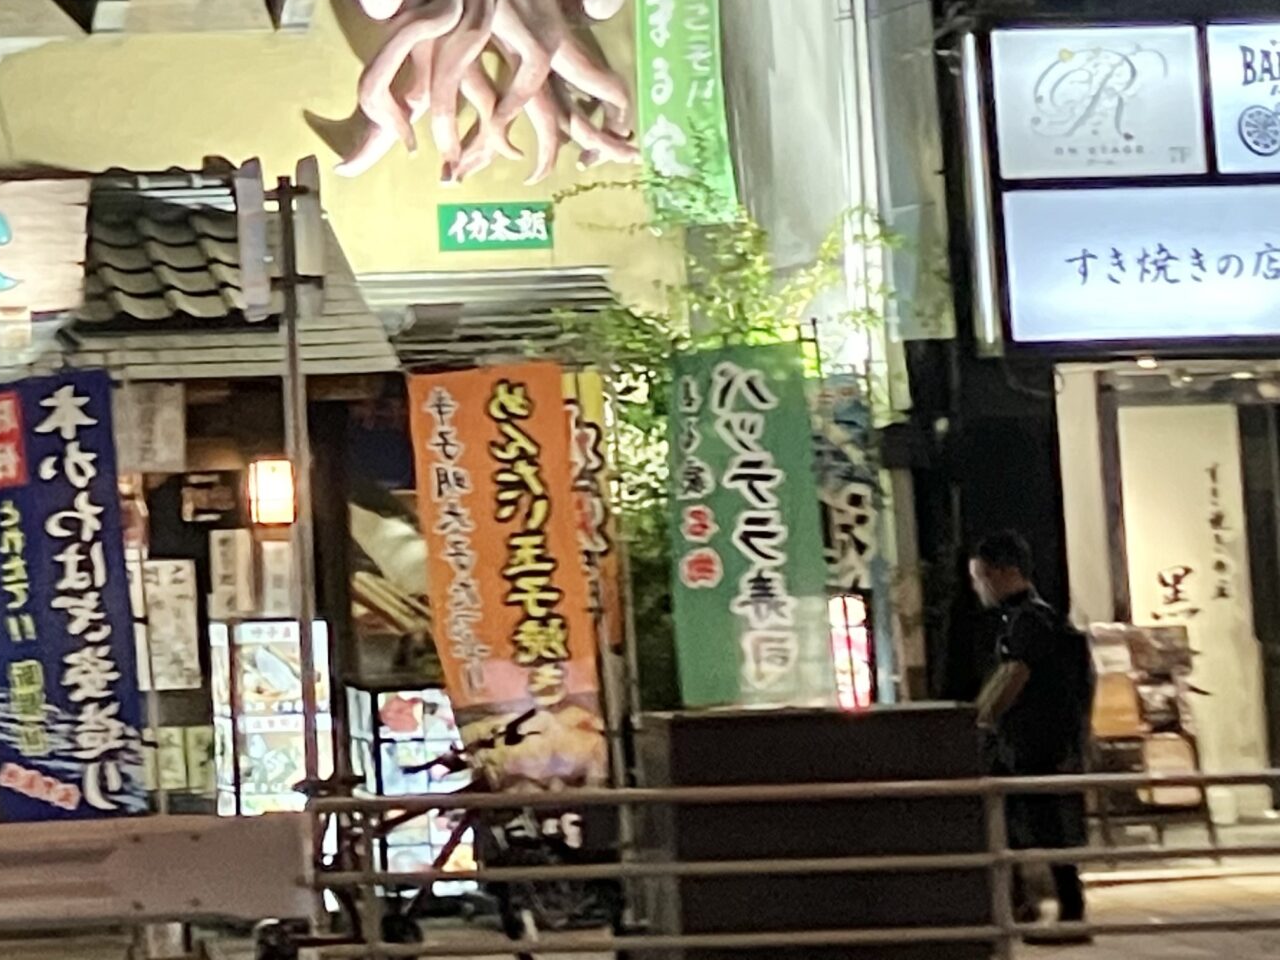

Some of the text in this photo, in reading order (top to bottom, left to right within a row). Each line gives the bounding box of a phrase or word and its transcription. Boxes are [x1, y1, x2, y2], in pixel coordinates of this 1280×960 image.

[1065, 242, 1280, 286] すき焼きの店
